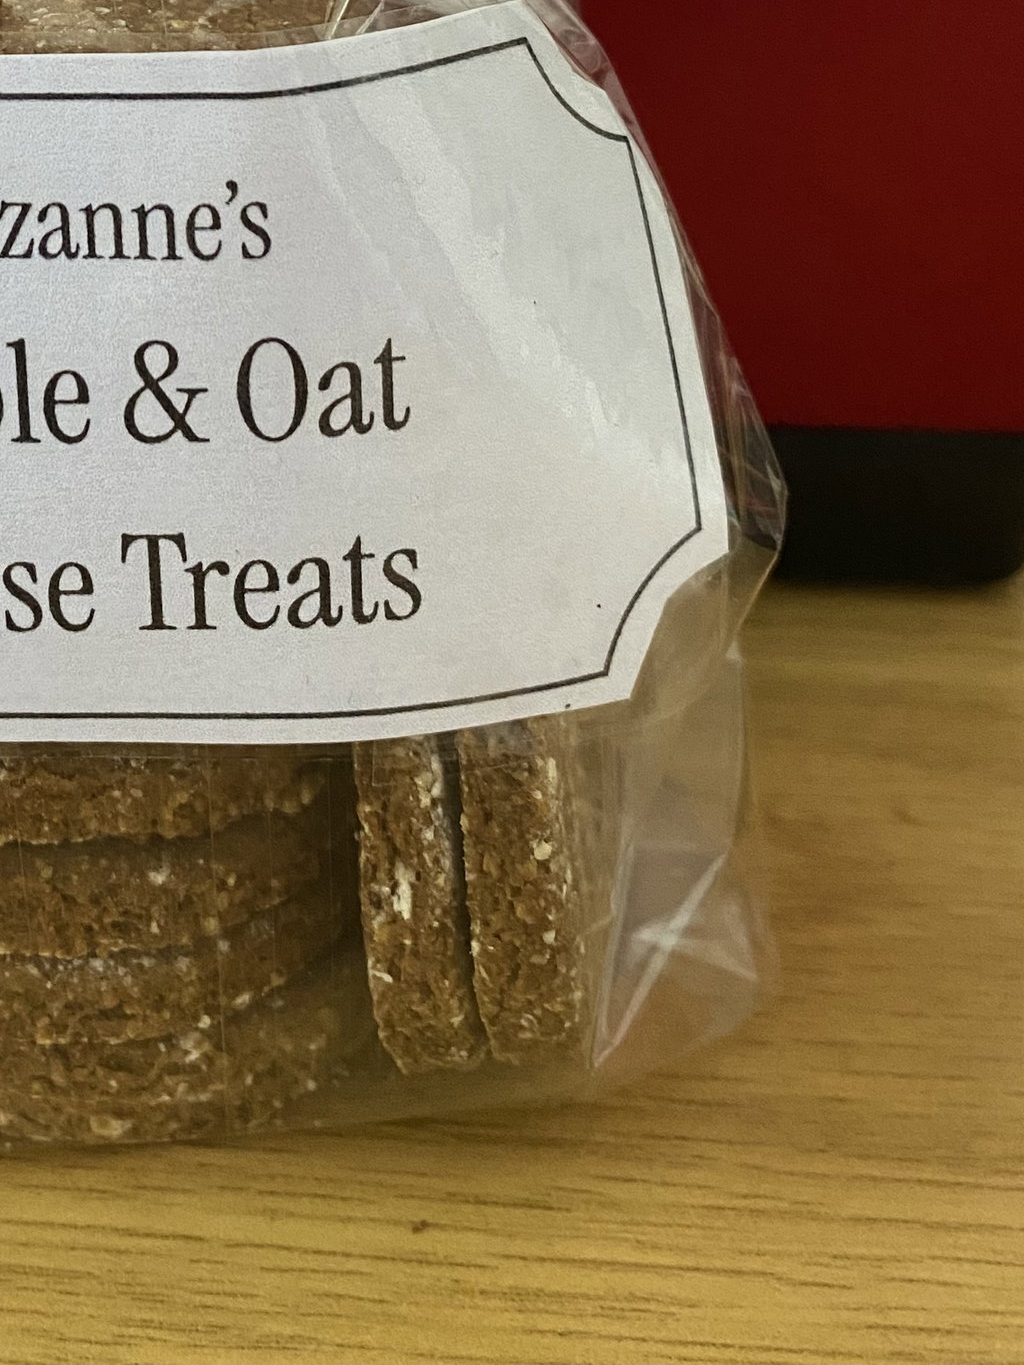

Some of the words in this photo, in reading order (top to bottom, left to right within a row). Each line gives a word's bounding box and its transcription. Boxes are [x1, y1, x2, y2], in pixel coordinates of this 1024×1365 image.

[123, 339, 211, 446] &
[236, 336, 411, 444] Oat
[120, 531, 422, 631] Treats
